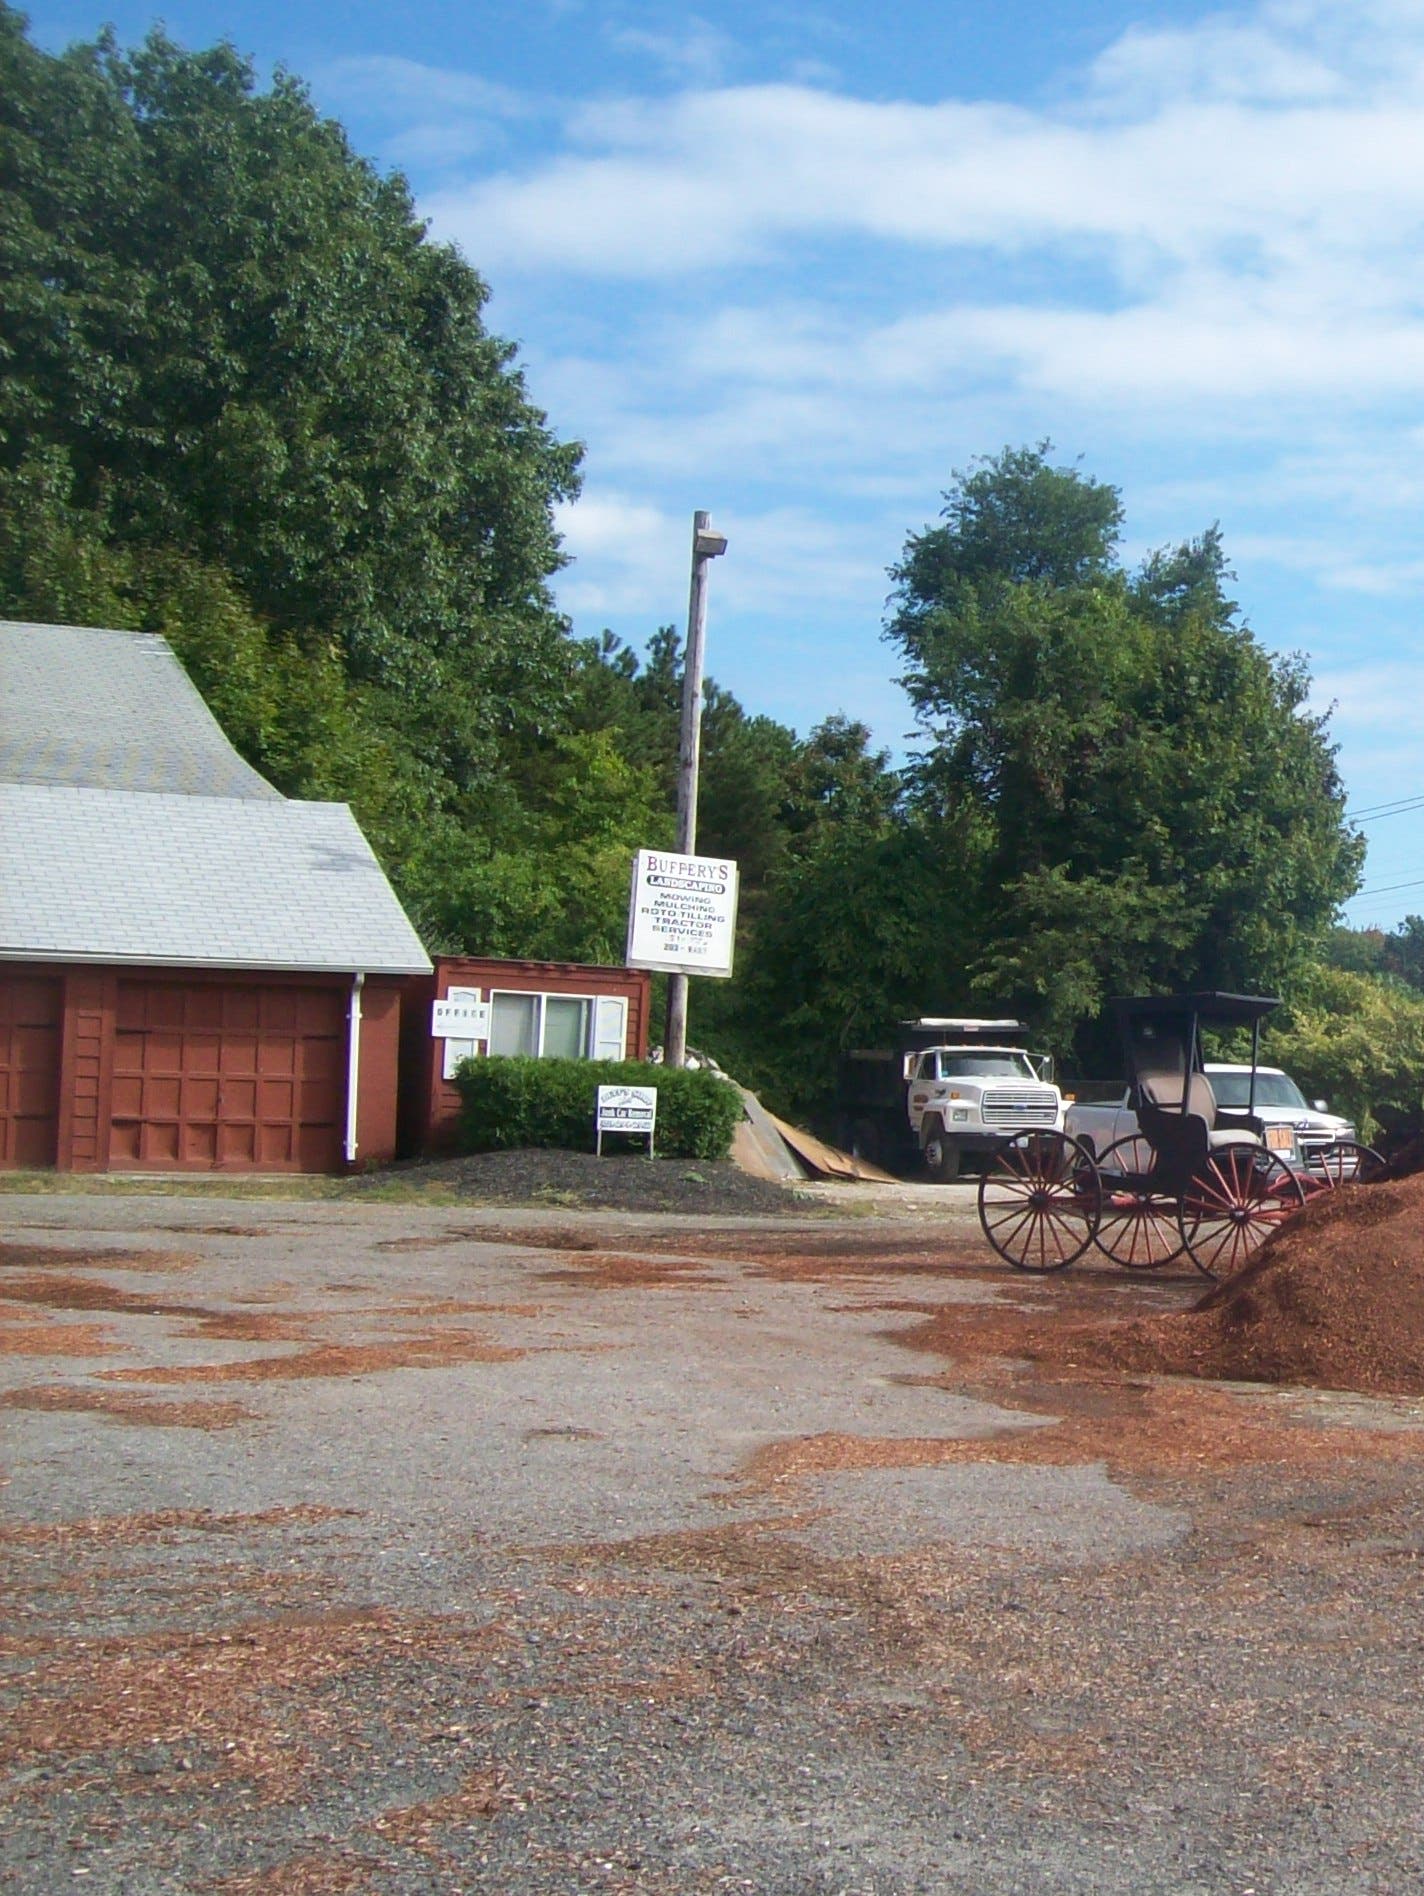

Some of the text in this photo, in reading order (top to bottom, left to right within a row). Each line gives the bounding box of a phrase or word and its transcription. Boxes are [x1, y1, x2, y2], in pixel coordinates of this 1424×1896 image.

[649, 876, 723, 894] LANDSCAPING
[660, 892, 711, 904] MOWING
[654, 900, 715, 913] MULCHING
[654, 916, 713, 929] TRACTOR
[652, 925, 713, 938] SERVICES
[437, 1008, 485, 1018] OFFICE
